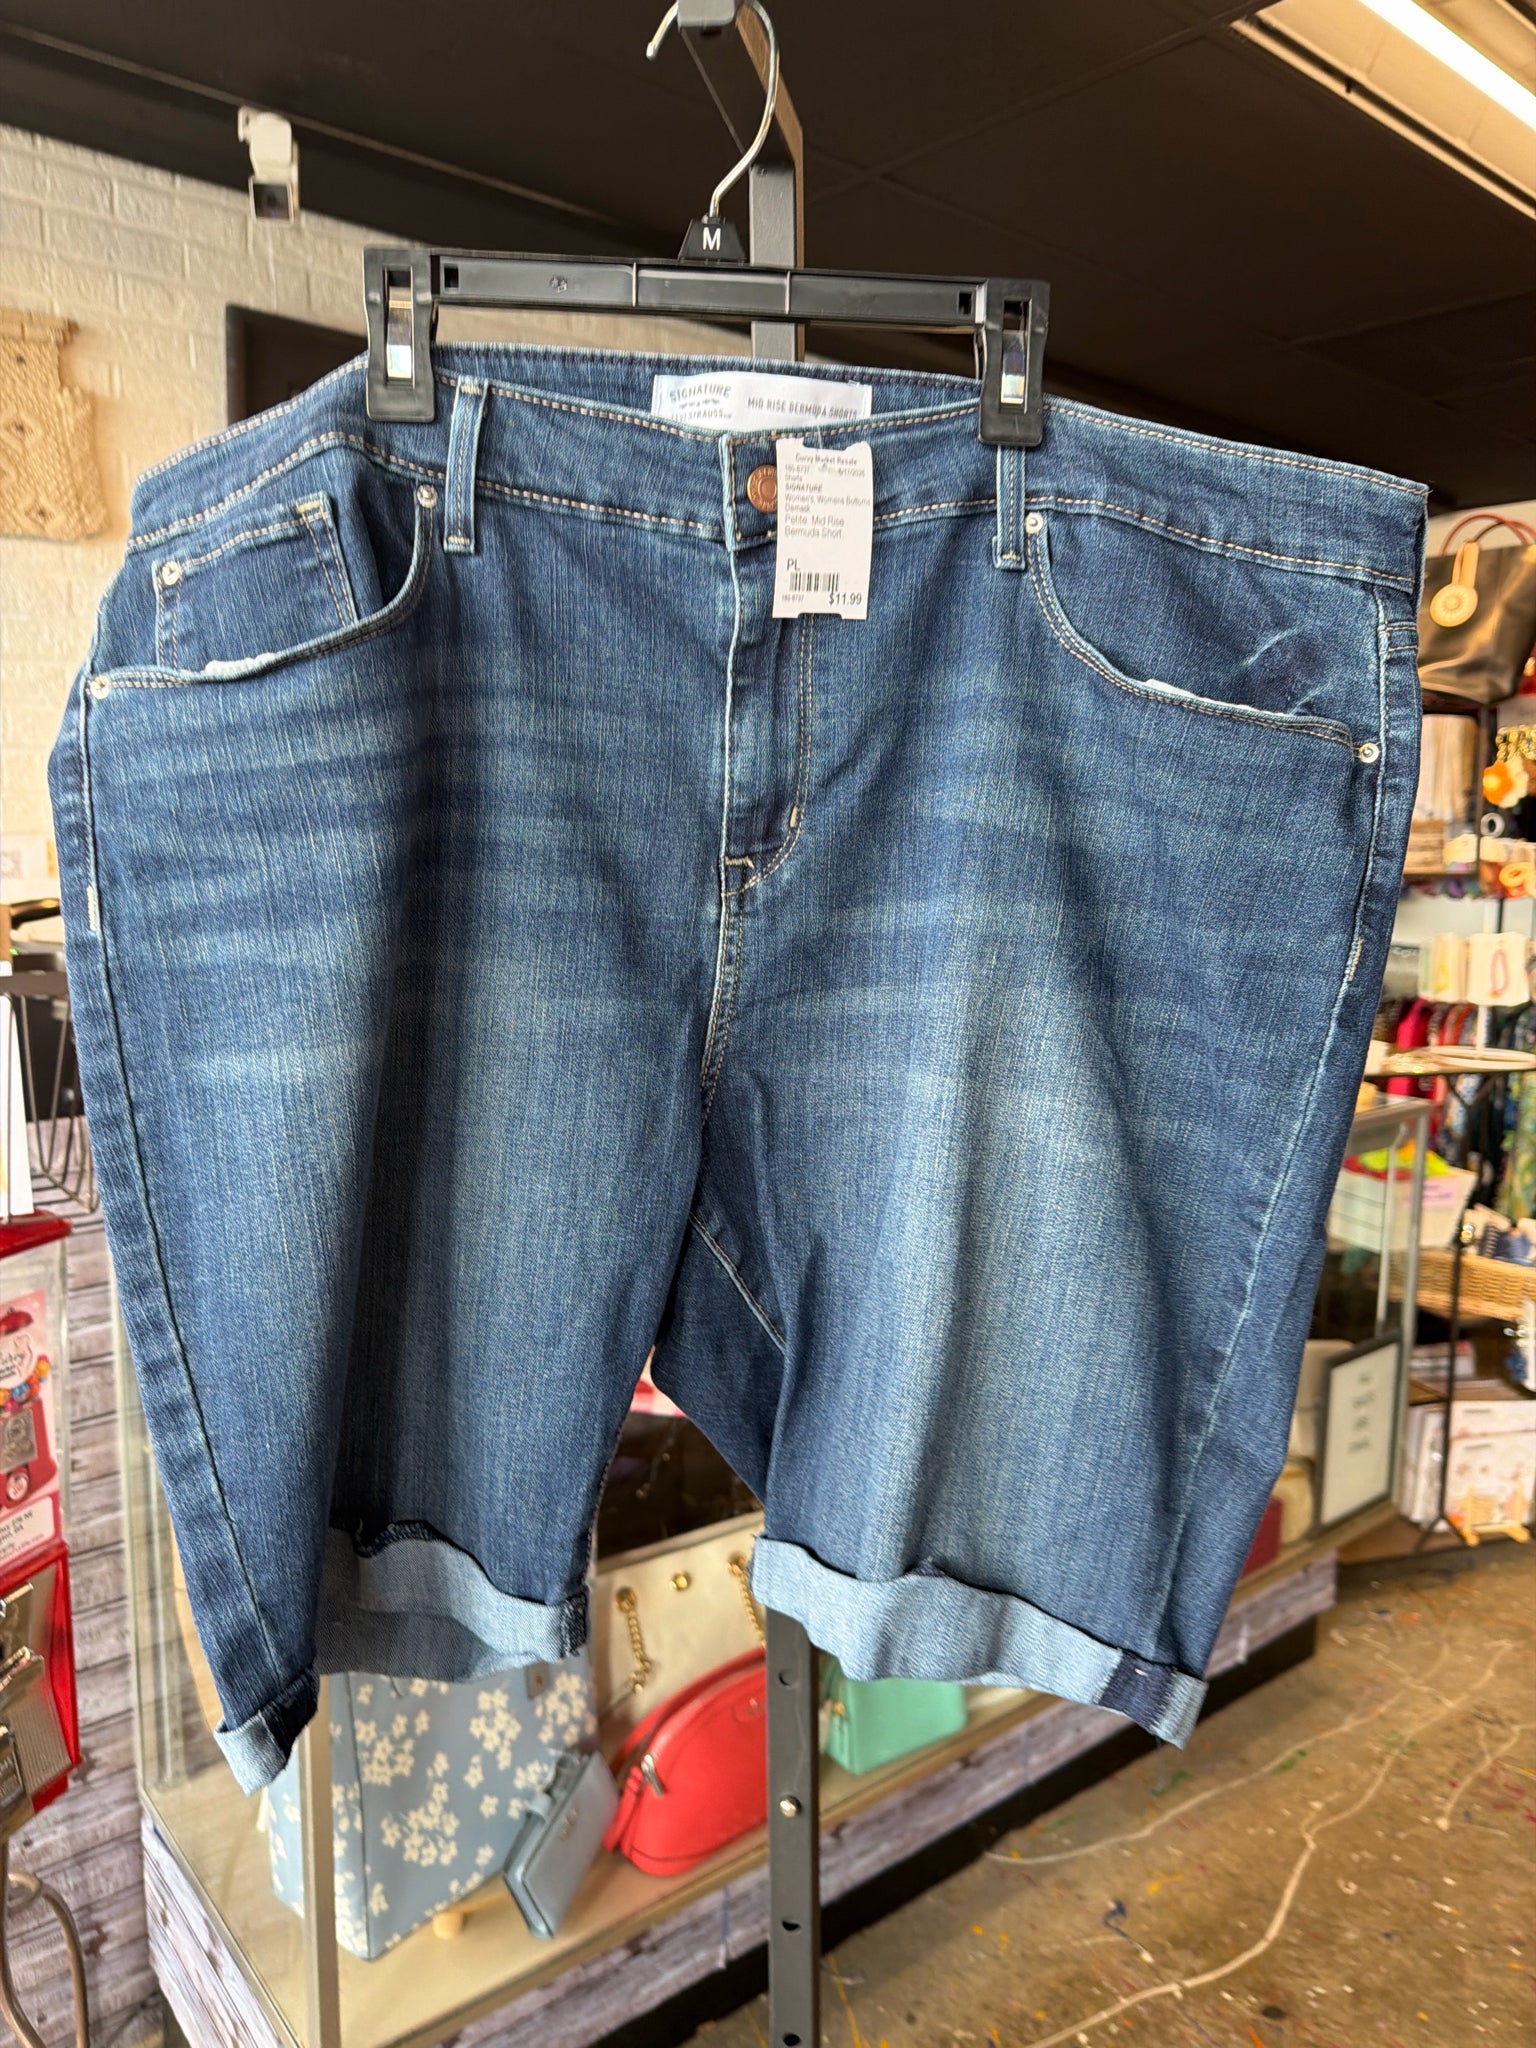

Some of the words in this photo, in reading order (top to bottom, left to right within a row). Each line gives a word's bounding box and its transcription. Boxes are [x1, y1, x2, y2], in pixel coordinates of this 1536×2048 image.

[703, 227, 721, 251] M
[670, 383, 732, 402] SIGNATURE
[747, 396, 764, 409] MID
[767, 398, 785, 412] RISE
[789, 401, 827, 417] BERMUDA
[829, 406, 858, 420] SHORTS
[785, 483, 822, 493] SIGNATURE
[811, 515, 826, 526] Mid
[827, 515, 845, 526] Rise
[785, 525, 820, 537] Bermuda
[787, 558, 800, 571] PL
[829, 591, 862, 606] $11.99
